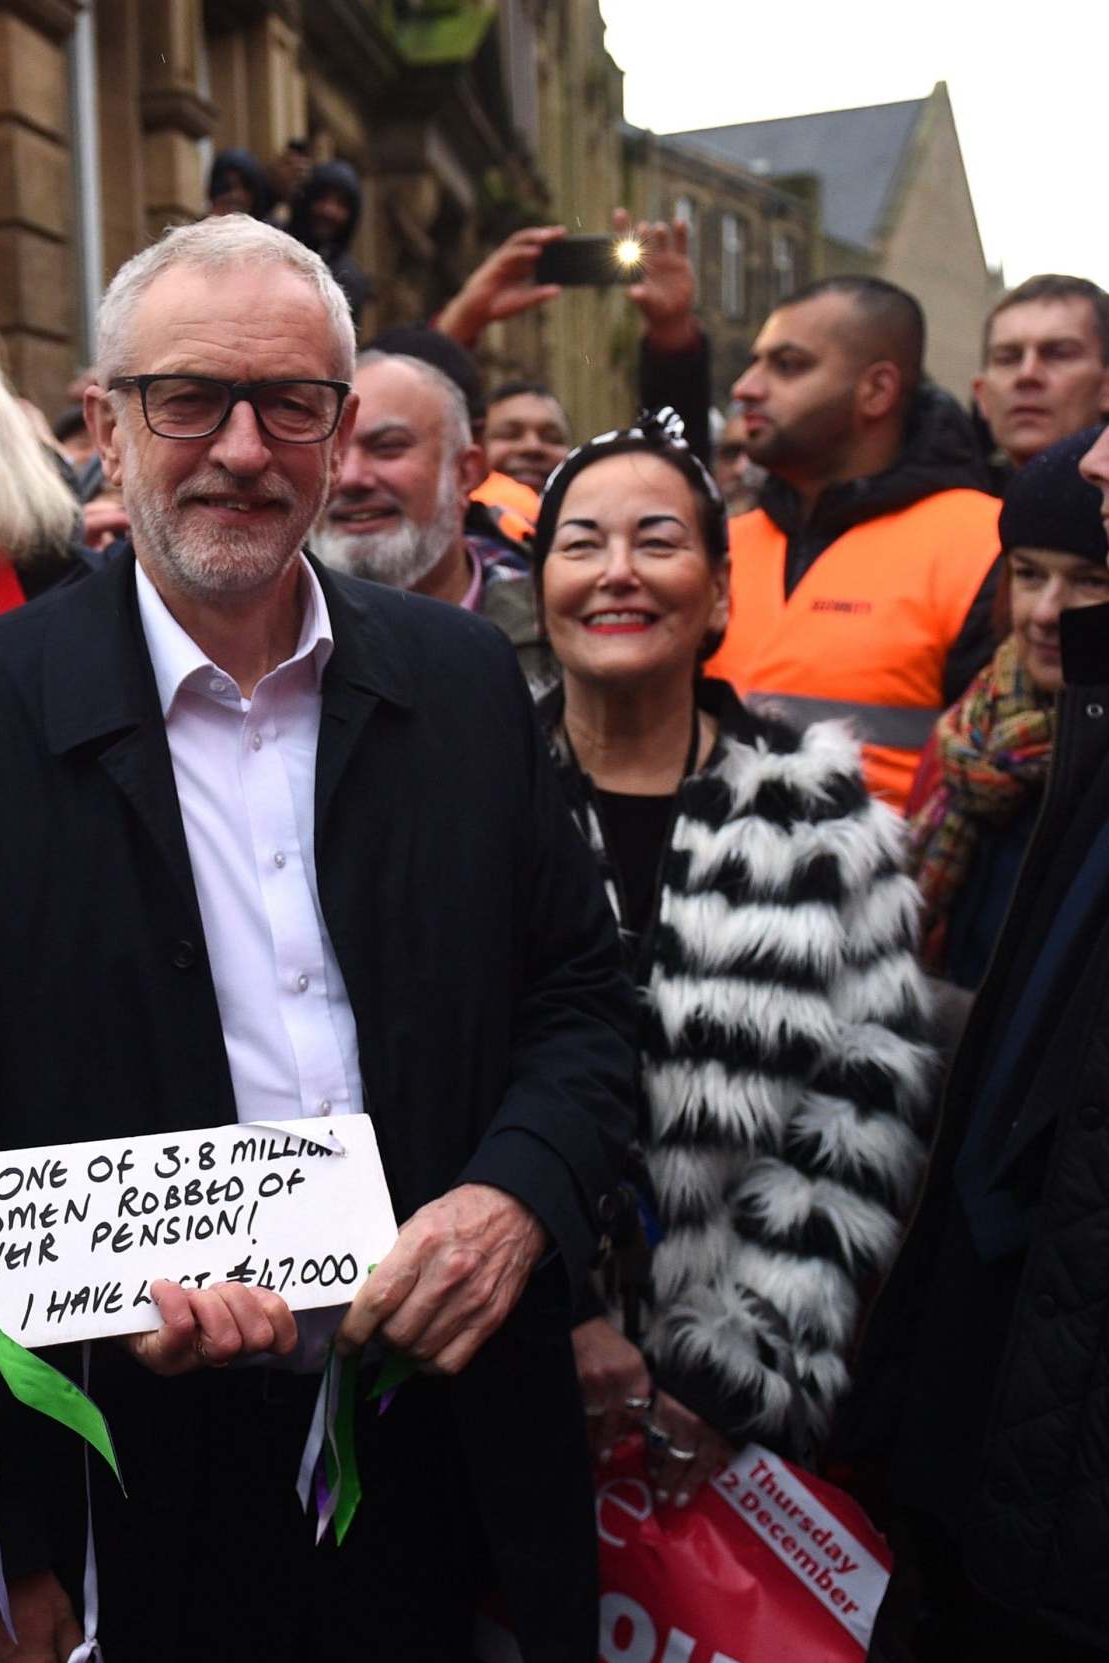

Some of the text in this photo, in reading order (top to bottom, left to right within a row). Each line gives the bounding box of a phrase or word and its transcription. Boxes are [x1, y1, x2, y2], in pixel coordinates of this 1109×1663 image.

[88, 1149, 135, 1184] OF
[154, 1141, 216, 1179] 3.8
[118, 1175, 244, 1218] ROBBED
[258, 1168, 306, 1197] OF
[91, 1201, 259, 1252] PENSION!
[21, 1293, 34, 1331] I
[47, 1282, 123, 1323] HAVE
[749, 1459, 859, 1575] Thursday
[741, 1491, 860, 1615] December
